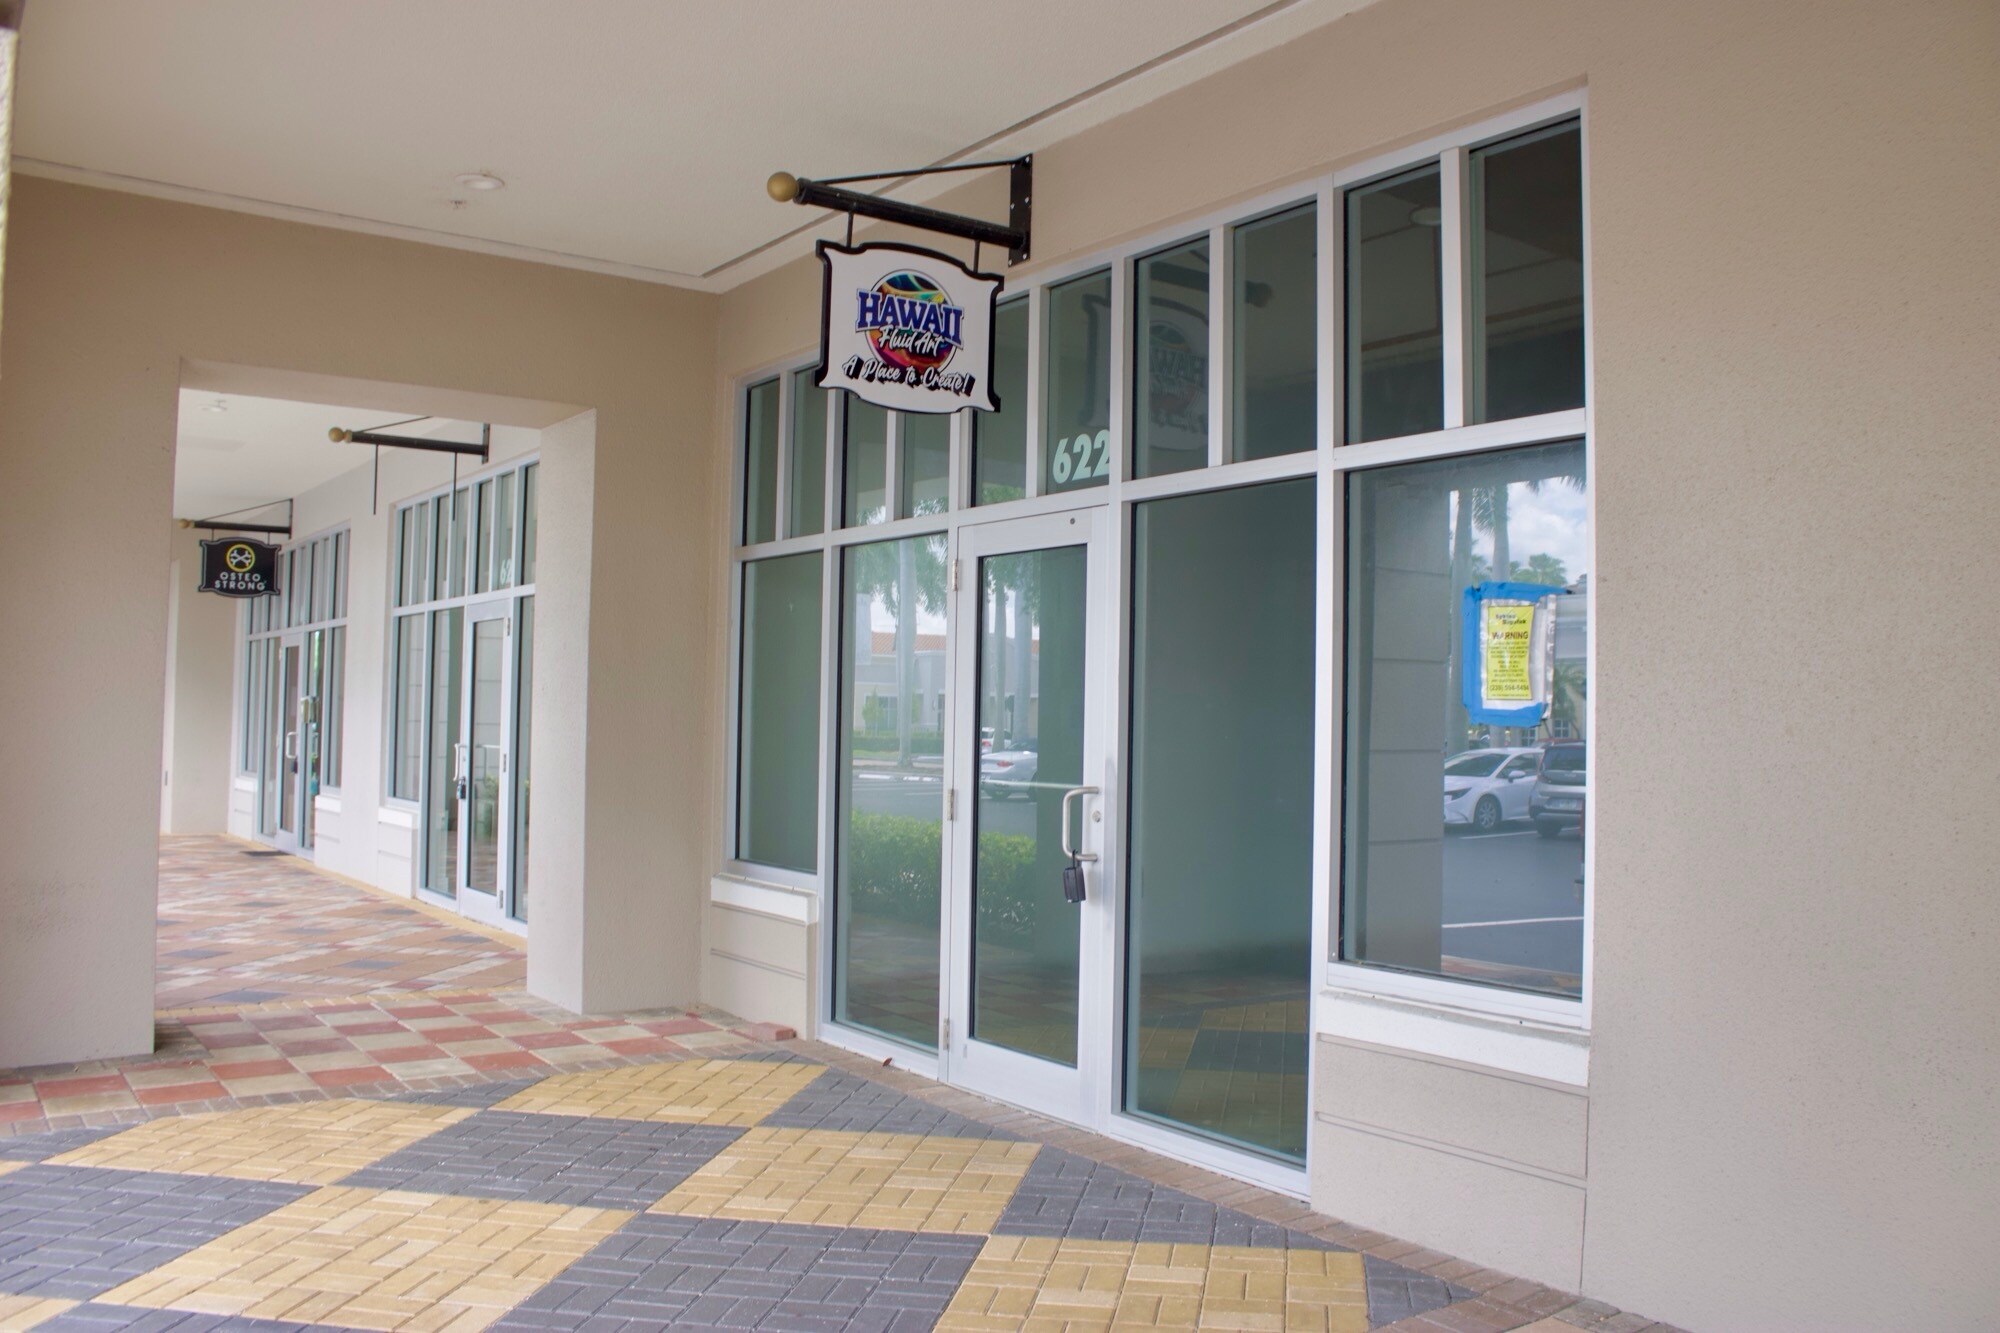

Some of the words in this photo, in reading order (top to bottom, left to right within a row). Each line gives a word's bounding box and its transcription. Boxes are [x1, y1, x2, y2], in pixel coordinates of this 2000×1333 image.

[856, 289, 964, 348] HAWAII
[878, 325, 914, 352] Fluid
[914, 332, 943, 356] Art
[842, 355, 860, 378] A
[862, 357, 902, 384] Place
[904, 365, 918, 387] to
[920, 368, 975, 396] Create!
[1053, 429, 1110, 484] 622
[214, 580, 265, 591] STRONG
[220, 572, 261, 582] OSTEO
[1492, 631, 1529, 640] WARNING
